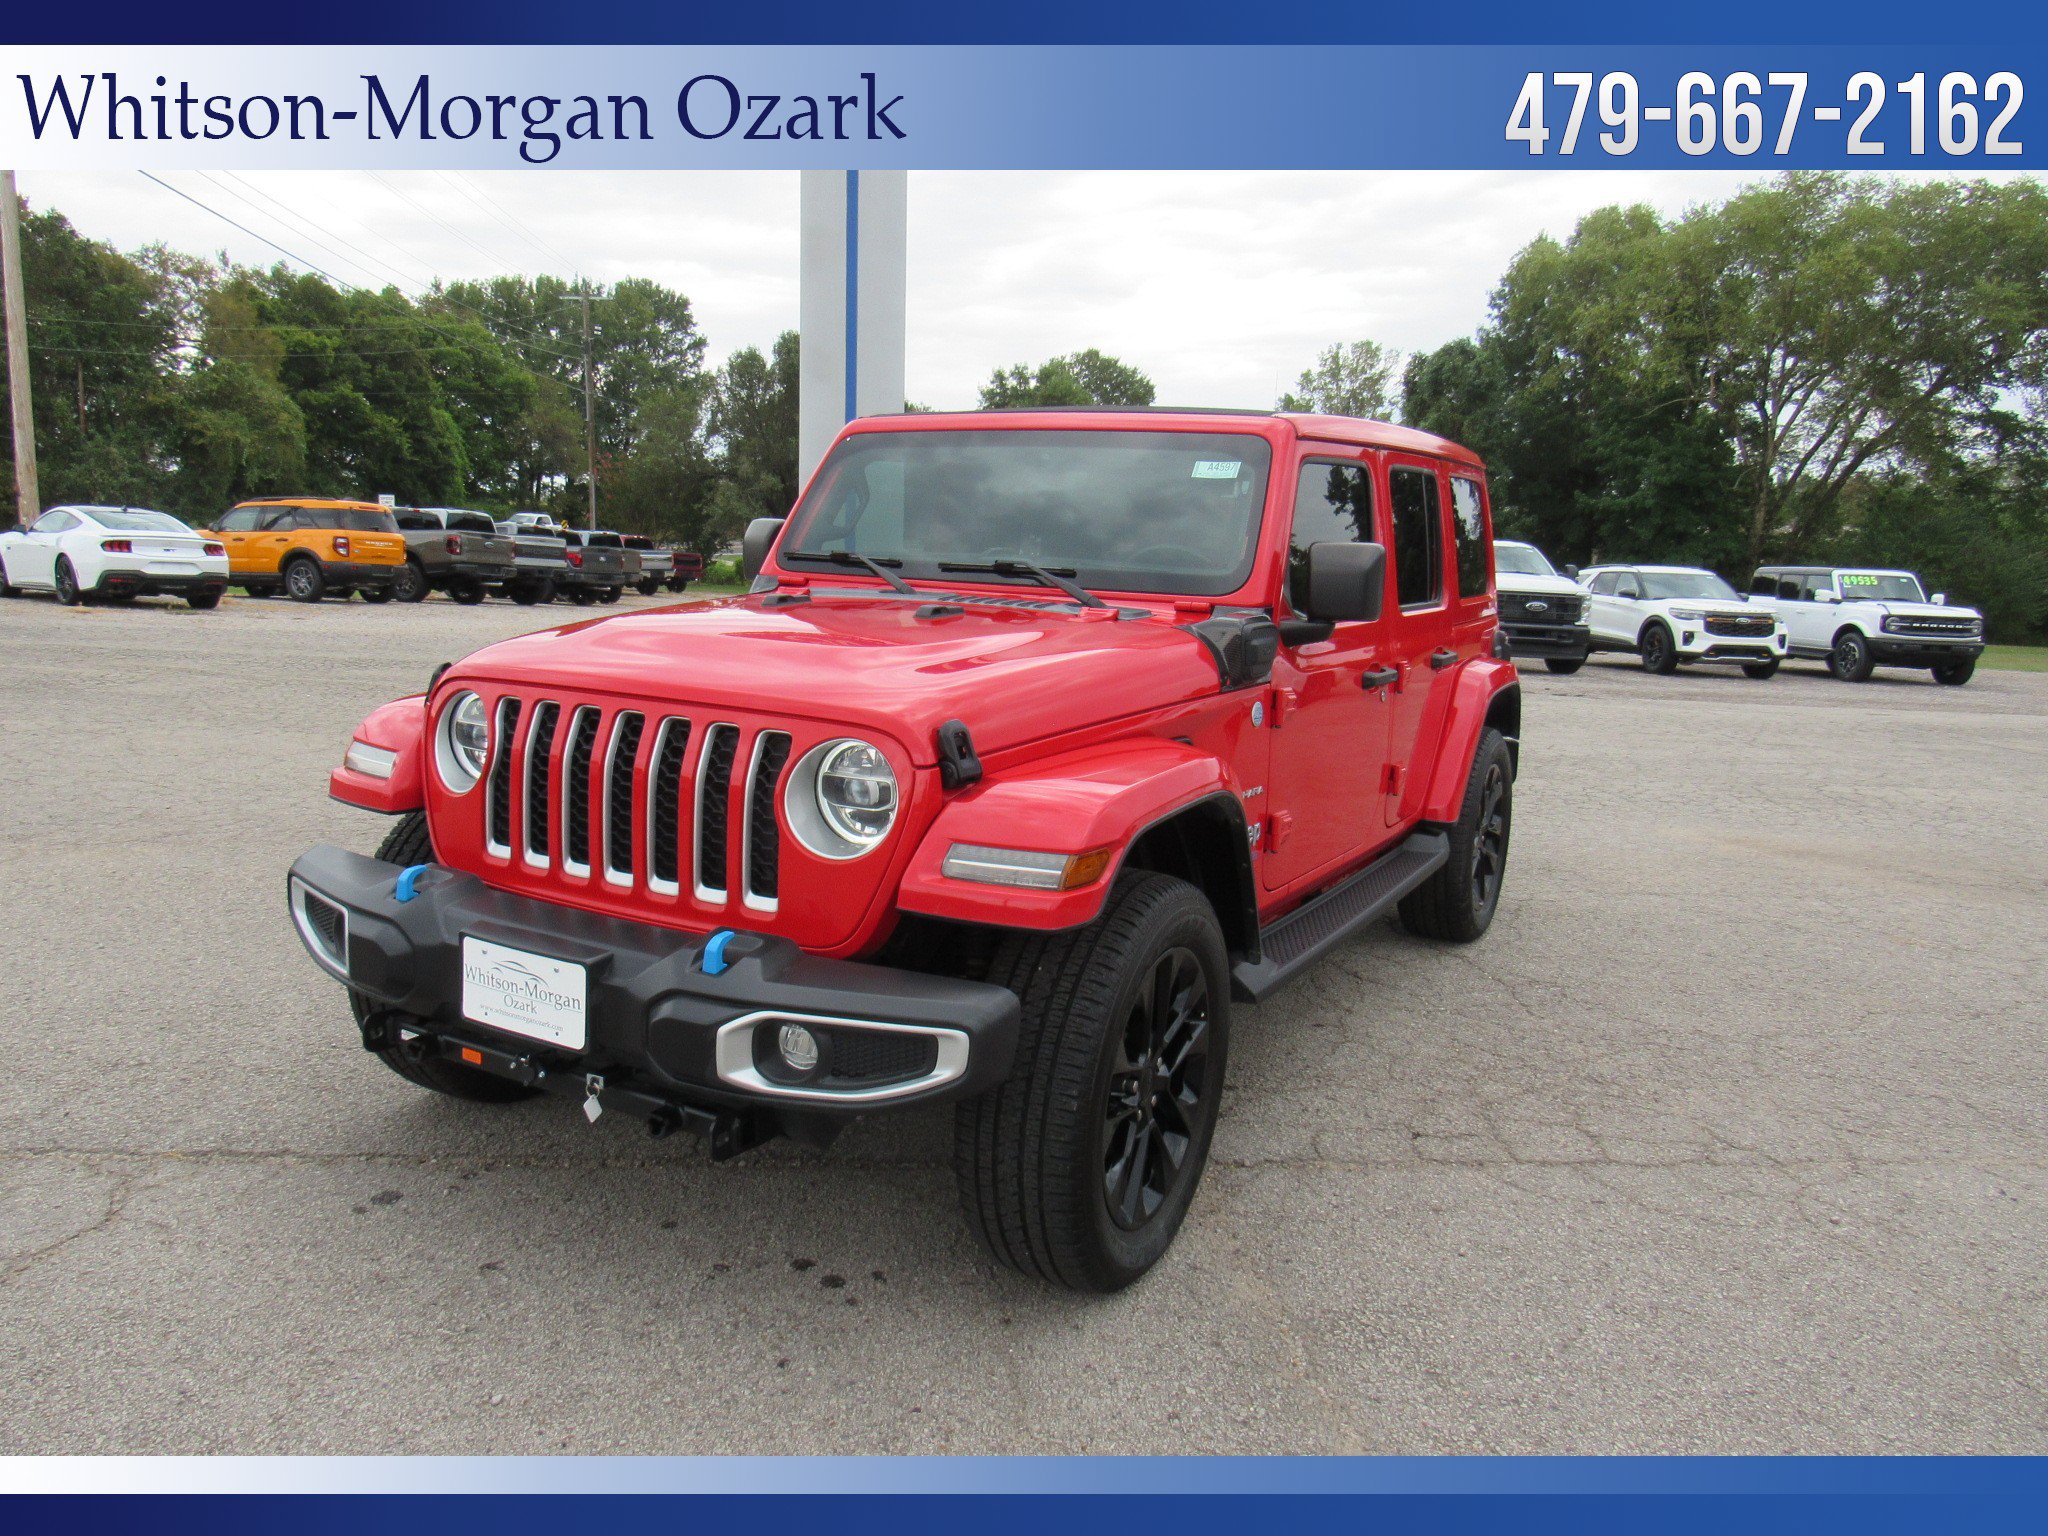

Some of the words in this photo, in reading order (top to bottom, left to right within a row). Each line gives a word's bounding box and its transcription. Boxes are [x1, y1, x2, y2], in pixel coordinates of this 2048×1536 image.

[1207, 462, 1237, 472] A4597
[464, 963, 581, 1011] Whitson-Morgan
[503, 994, 538, 1015] Ozark
